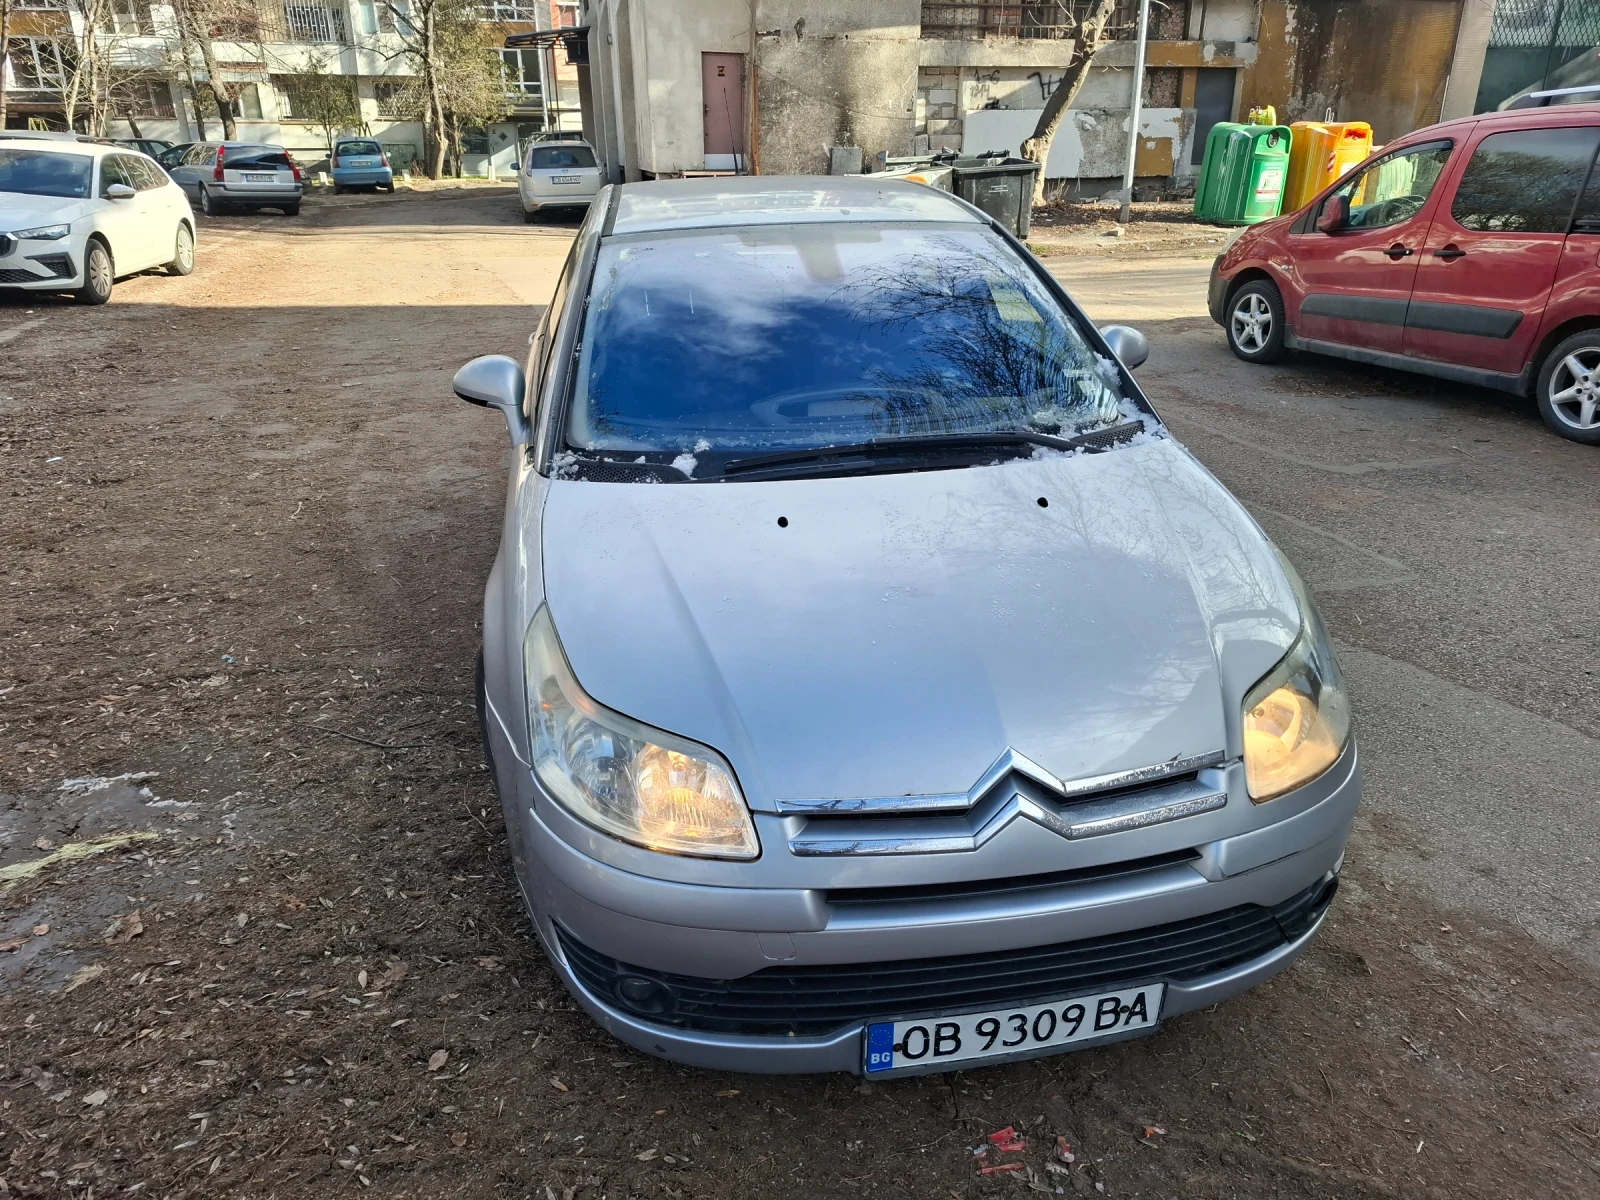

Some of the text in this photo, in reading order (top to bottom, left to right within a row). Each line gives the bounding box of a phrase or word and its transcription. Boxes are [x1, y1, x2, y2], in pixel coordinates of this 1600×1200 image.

[902, 991, 1149, 1060] OB 9309 BA
[871, 1052, 891, 1064] BG
